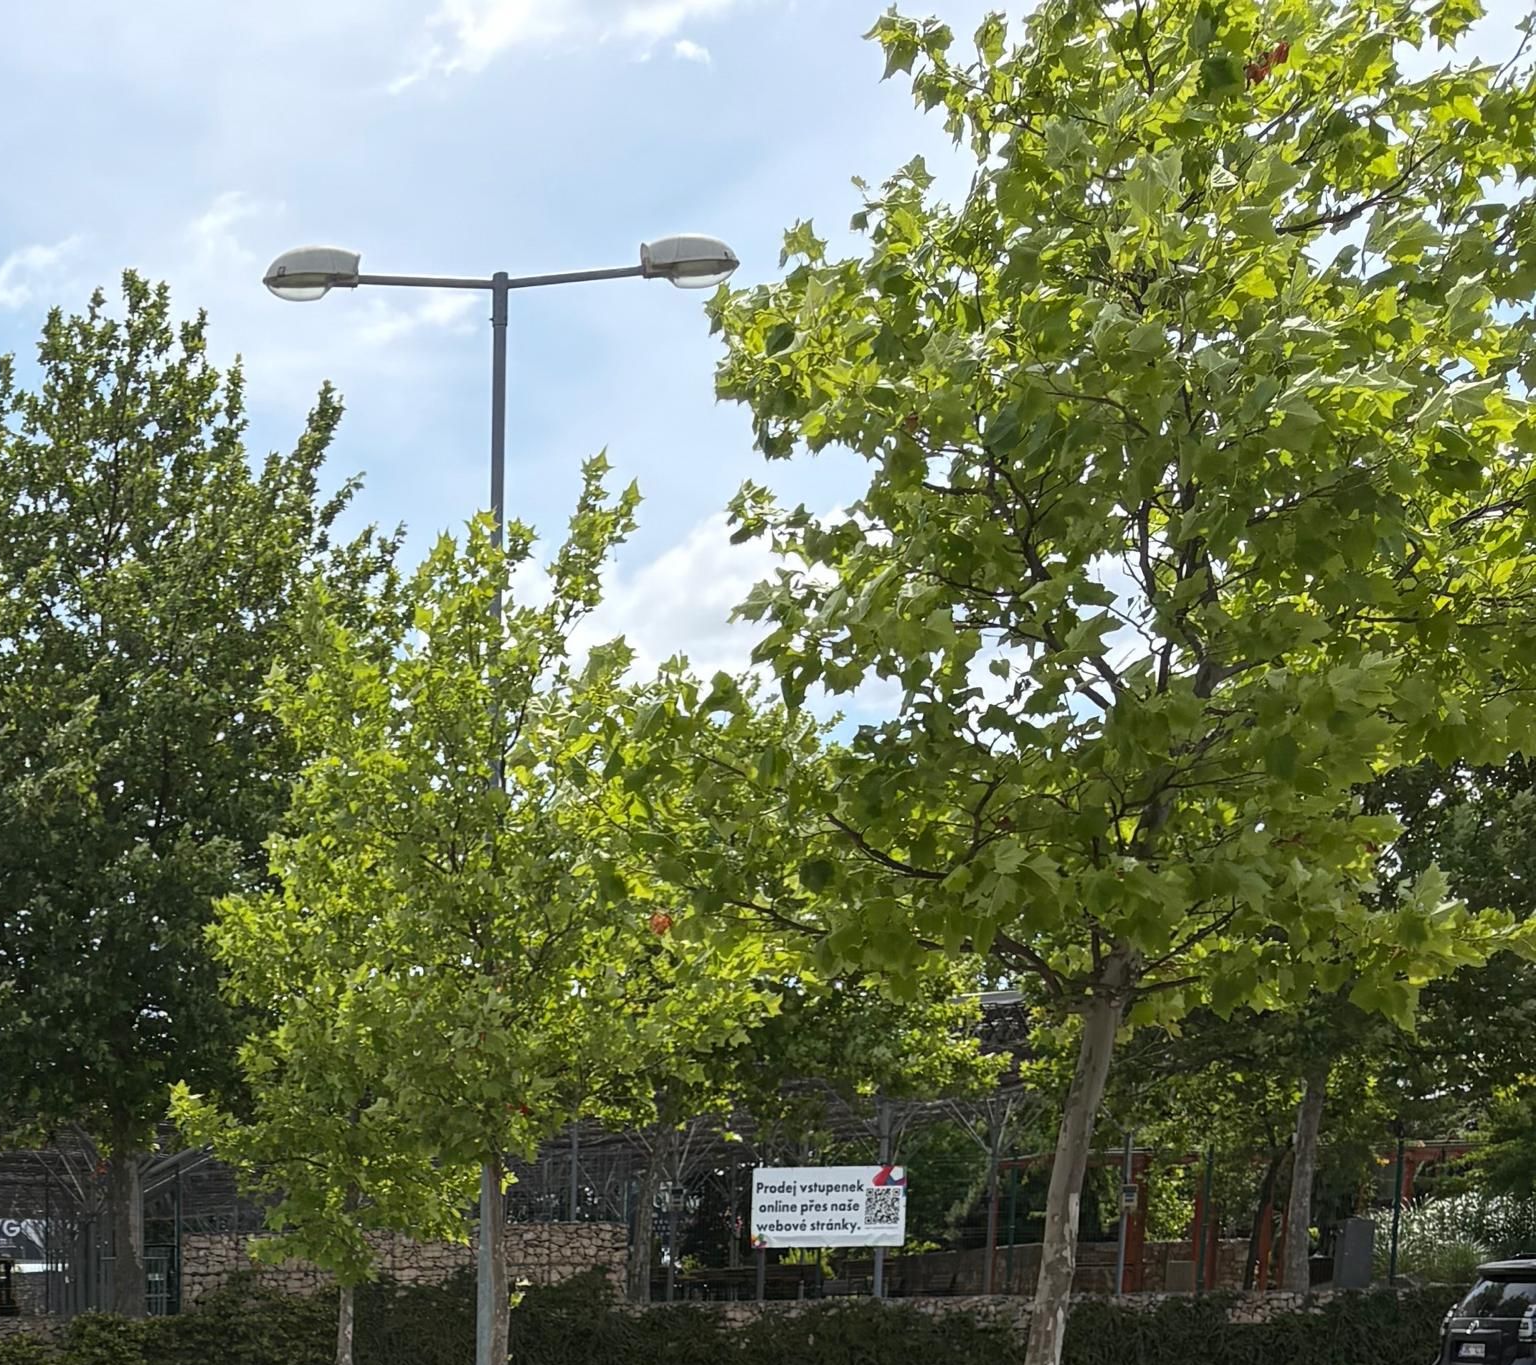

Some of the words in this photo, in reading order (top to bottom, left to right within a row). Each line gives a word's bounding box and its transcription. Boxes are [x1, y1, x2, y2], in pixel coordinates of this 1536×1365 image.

[756, 1180, 797, 1197] Prodej
[799, 1179, 864, 1197] vstupenek
[759, 1200, 797, 1213] online
[800, 1199, 828, 1216] přes
[830, 1199, 860, 1212] naše
[756, 1219, 807, 1232] webové
[809, 1218, 861, 1234] stránky.
